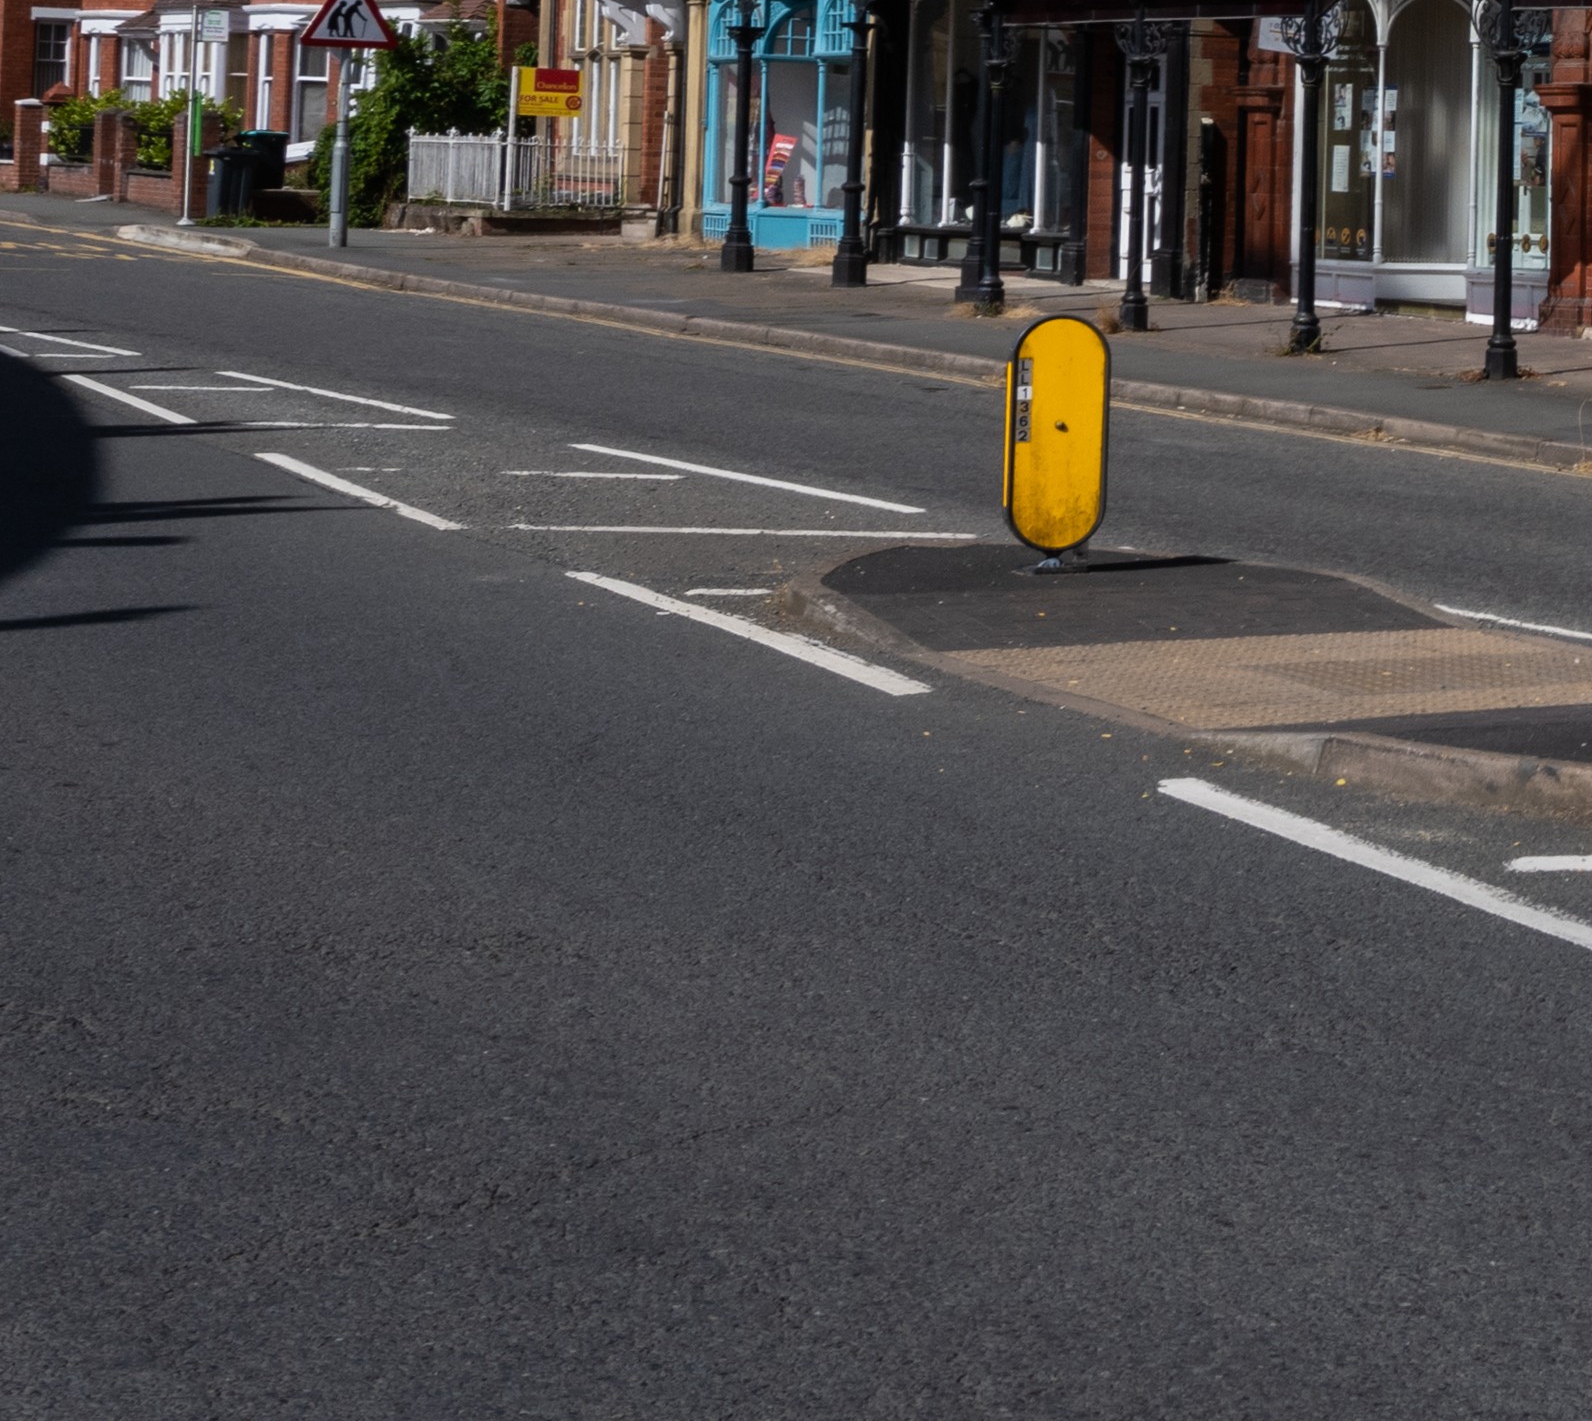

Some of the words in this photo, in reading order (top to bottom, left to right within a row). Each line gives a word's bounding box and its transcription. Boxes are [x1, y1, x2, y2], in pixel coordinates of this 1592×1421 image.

[519, 95, 537, 103] FOR
[539, 96, 560, 104] SALE
[1018, 360, 1031, 442] LL1362
